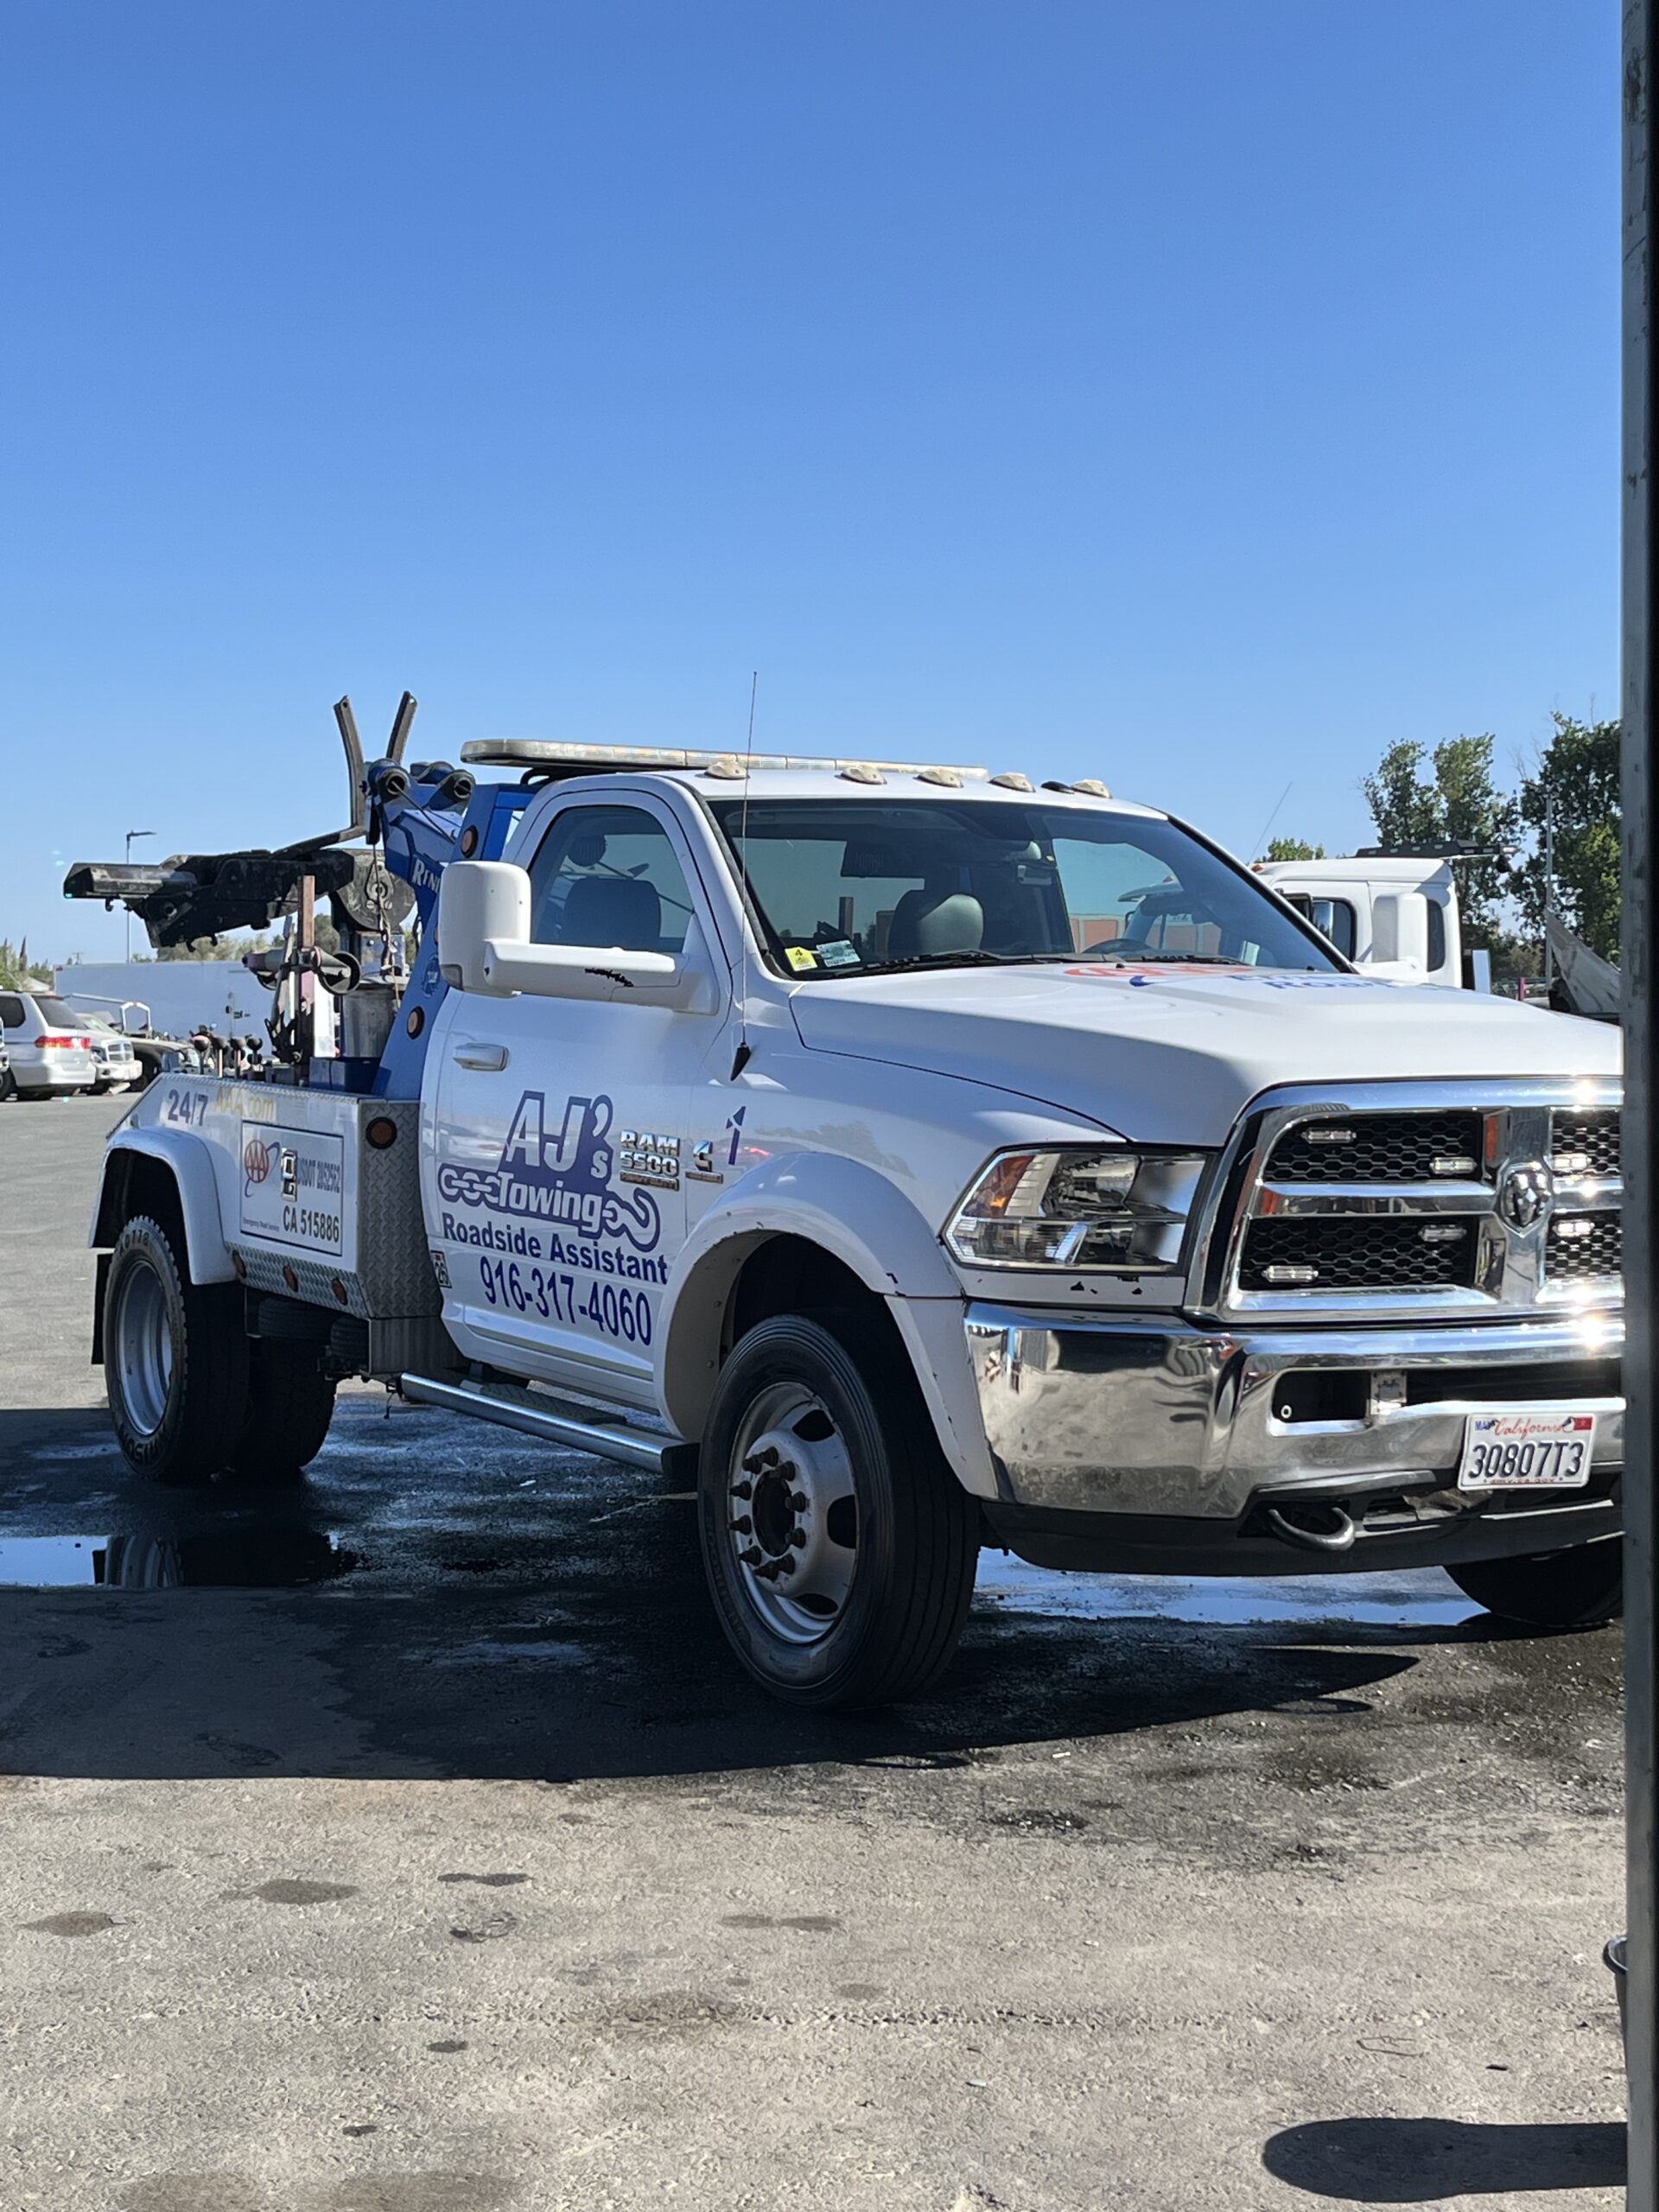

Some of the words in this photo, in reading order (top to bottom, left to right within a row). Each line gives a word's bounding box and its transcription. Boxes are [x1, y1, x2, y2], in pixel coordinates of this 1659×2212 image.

[168, 1089, 208, 1127] 24/7
[620, 1129, 680, 1156] RAM
[620, 1150, 679, 1178] 5500
[496, 1170, 603, 1235] Towing
[283, 1205, 298, 1233] CA
[300, 1209, 340, 1243] 515886
[442, 1212, 542, 1259] Roadside
[550, 1233, 668, 1285] Assistant
[480, 1255, 652, 1345] 916-317-4060
[1469, 1441, 1585, 1478] 30807T3
